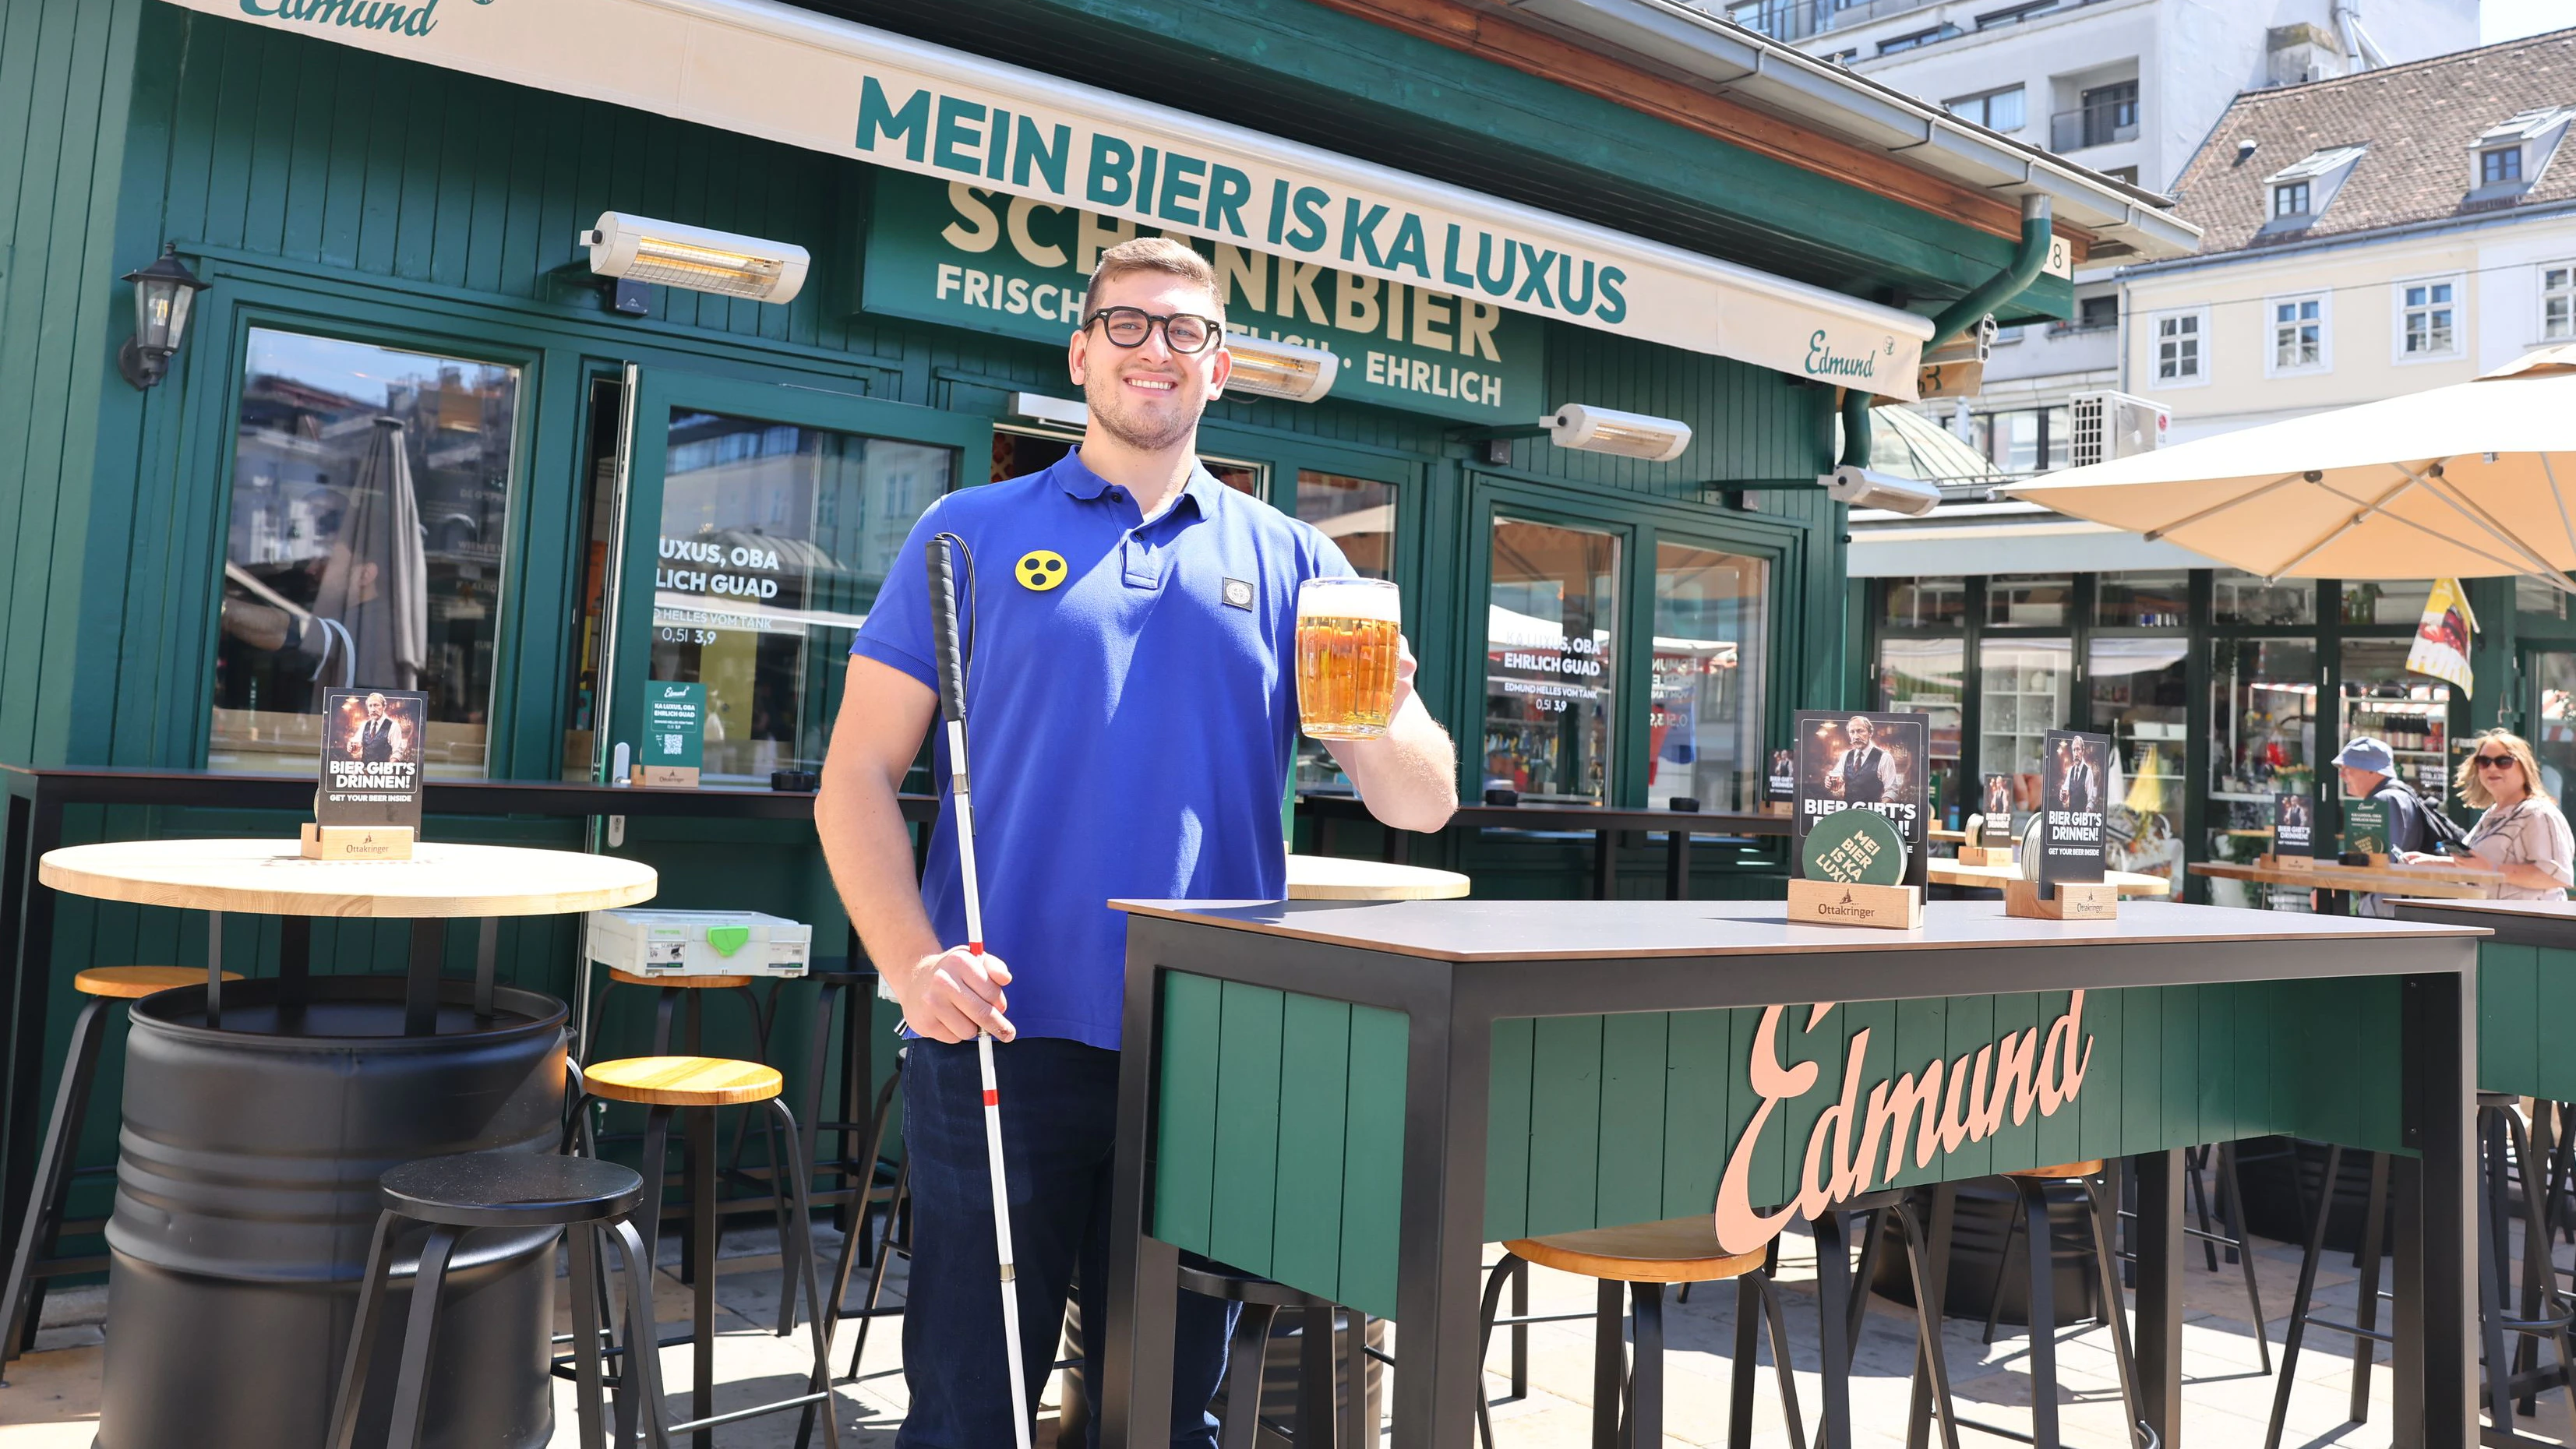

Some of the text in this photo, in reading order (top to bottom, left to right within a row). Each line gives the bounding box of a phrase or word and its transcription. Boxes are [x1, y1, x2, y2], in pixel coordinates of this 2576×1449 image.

[856, 75, 1628, 325] MEIN BIER IS KA LUXUS
[940, 179, 1502, 363] SCHNKBIER
[1804, 330, 1876, 378] Edmund
[1366, 351, 1502, 407] EHRLICH
[731, 547, 779, 570] OBA
[711, 574, 778, 598] GUAD
[663, 609, 708, 623] HELLES
[710, 613, 737, 626] VOM
[739, 615, 772, 629] TANK
[694, 629, 717, 646] 3,9
[1573, 637, 1601, 654] OBA
[1504, 653, 1600, 676] EHRLICH GUAD
[1505, 682, 1598, 700] EDMUND HELLES VOM TANK
[1554, 700, 1567, 713] 3,9
[330, 760, 415, 776] BIER GIBT'S
[336, 774, 410, 789] DRINNEN!
[2048, 810, 2102, 827] BIER GIBT'S
[1854, 830, 1881, 856] MEI
[2052, 826, 2099, 842] DRINNEN!
[346, 844, 390, 854] Ottakringer
[1840, 837, 1872, 870] BIER
[2084, 848, 2100, 857] INSIDE
[1830, 847, 1847, 863] IS
[1842, 860, 1863, 882] KA
[1818, 903, 1876, 919] Ottakringer
[2077, 903, 2103, 914] Ottakringer
[1713, 989, 2094, 1255] Edmund
